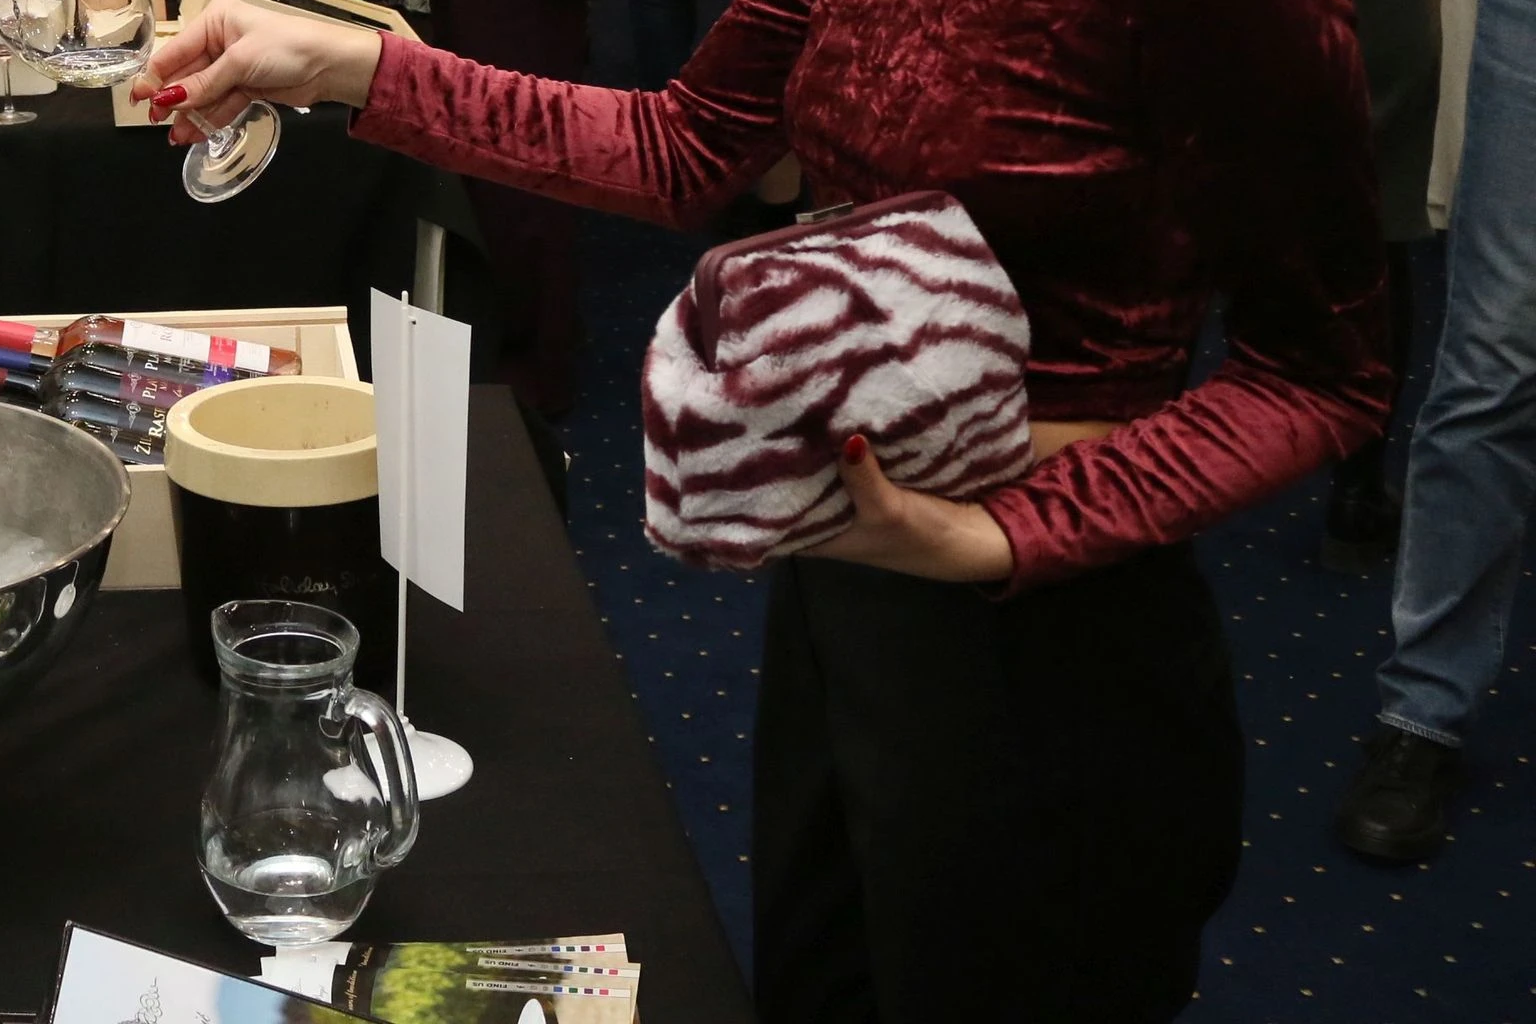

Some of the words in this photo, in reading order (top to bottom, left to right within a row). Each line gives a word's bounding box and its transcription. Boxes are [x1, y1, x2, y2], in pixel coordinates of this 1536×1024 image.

[144, 352, 161, 372] PLA
[141, 378, 159, 400] PLA
[133, 435, 153, 456] ŽIL
